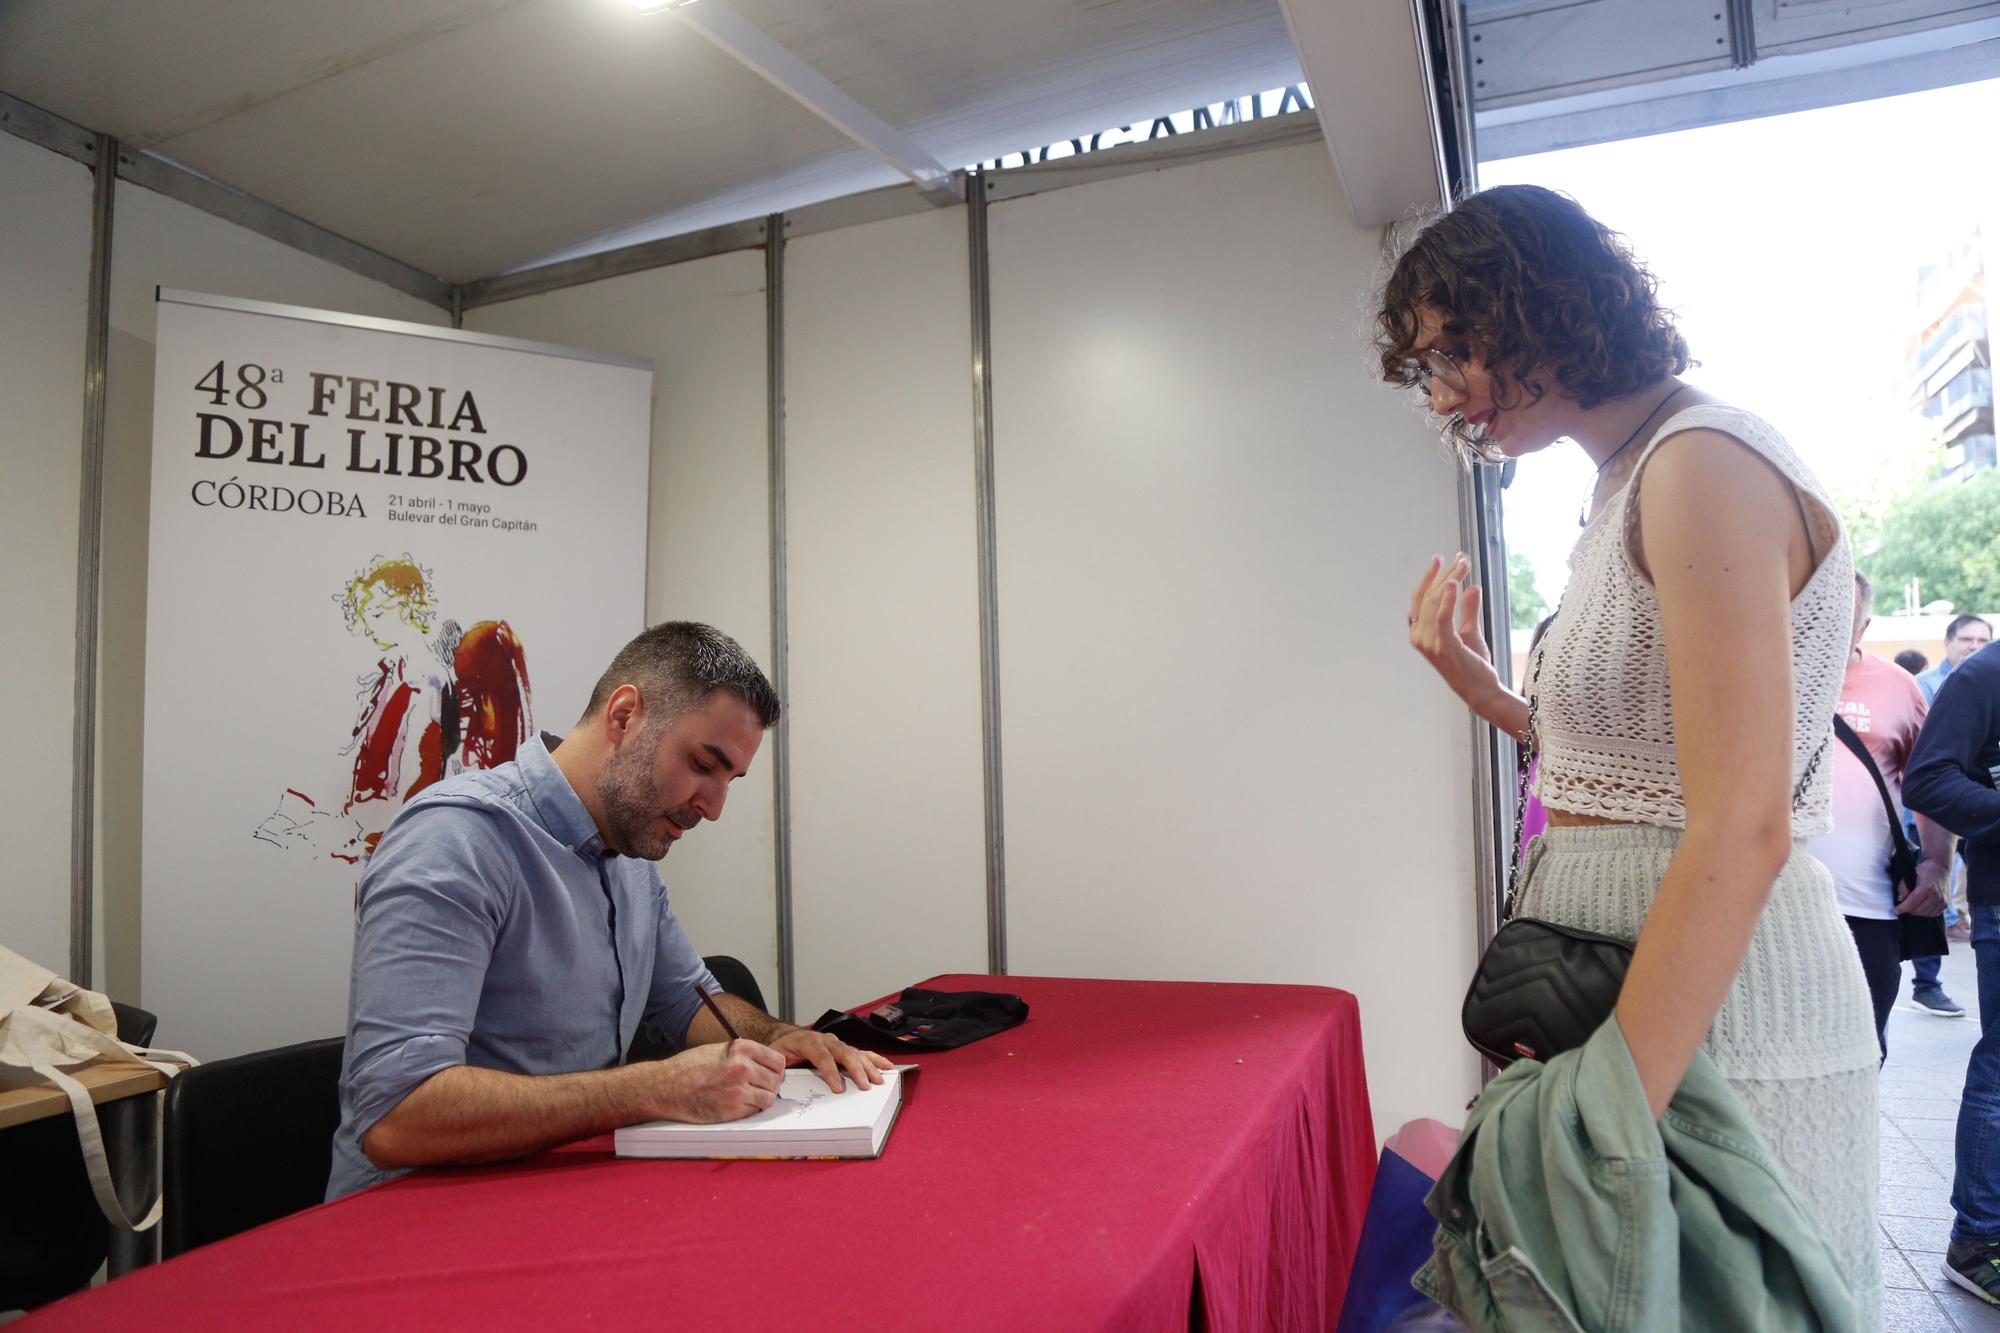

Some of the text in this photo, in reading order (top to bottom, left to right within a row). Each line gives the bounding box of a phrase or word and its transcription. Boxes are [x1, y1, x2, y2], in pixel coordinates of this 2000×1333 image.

[194, 360, 487, 434] 48ª FERIA
[195, 412, 528, 487] DEL LIBRO
[191, 476, 368, 518] CÓRDOBA
[388, 494, 403, 507] 21
[408, 496, 436, 509] abril
[447, 499, 453, 510] 1
[457, 501, 491, 515] mayo
[388, 509, 538, 533] Bulevar del Gran Capitán
